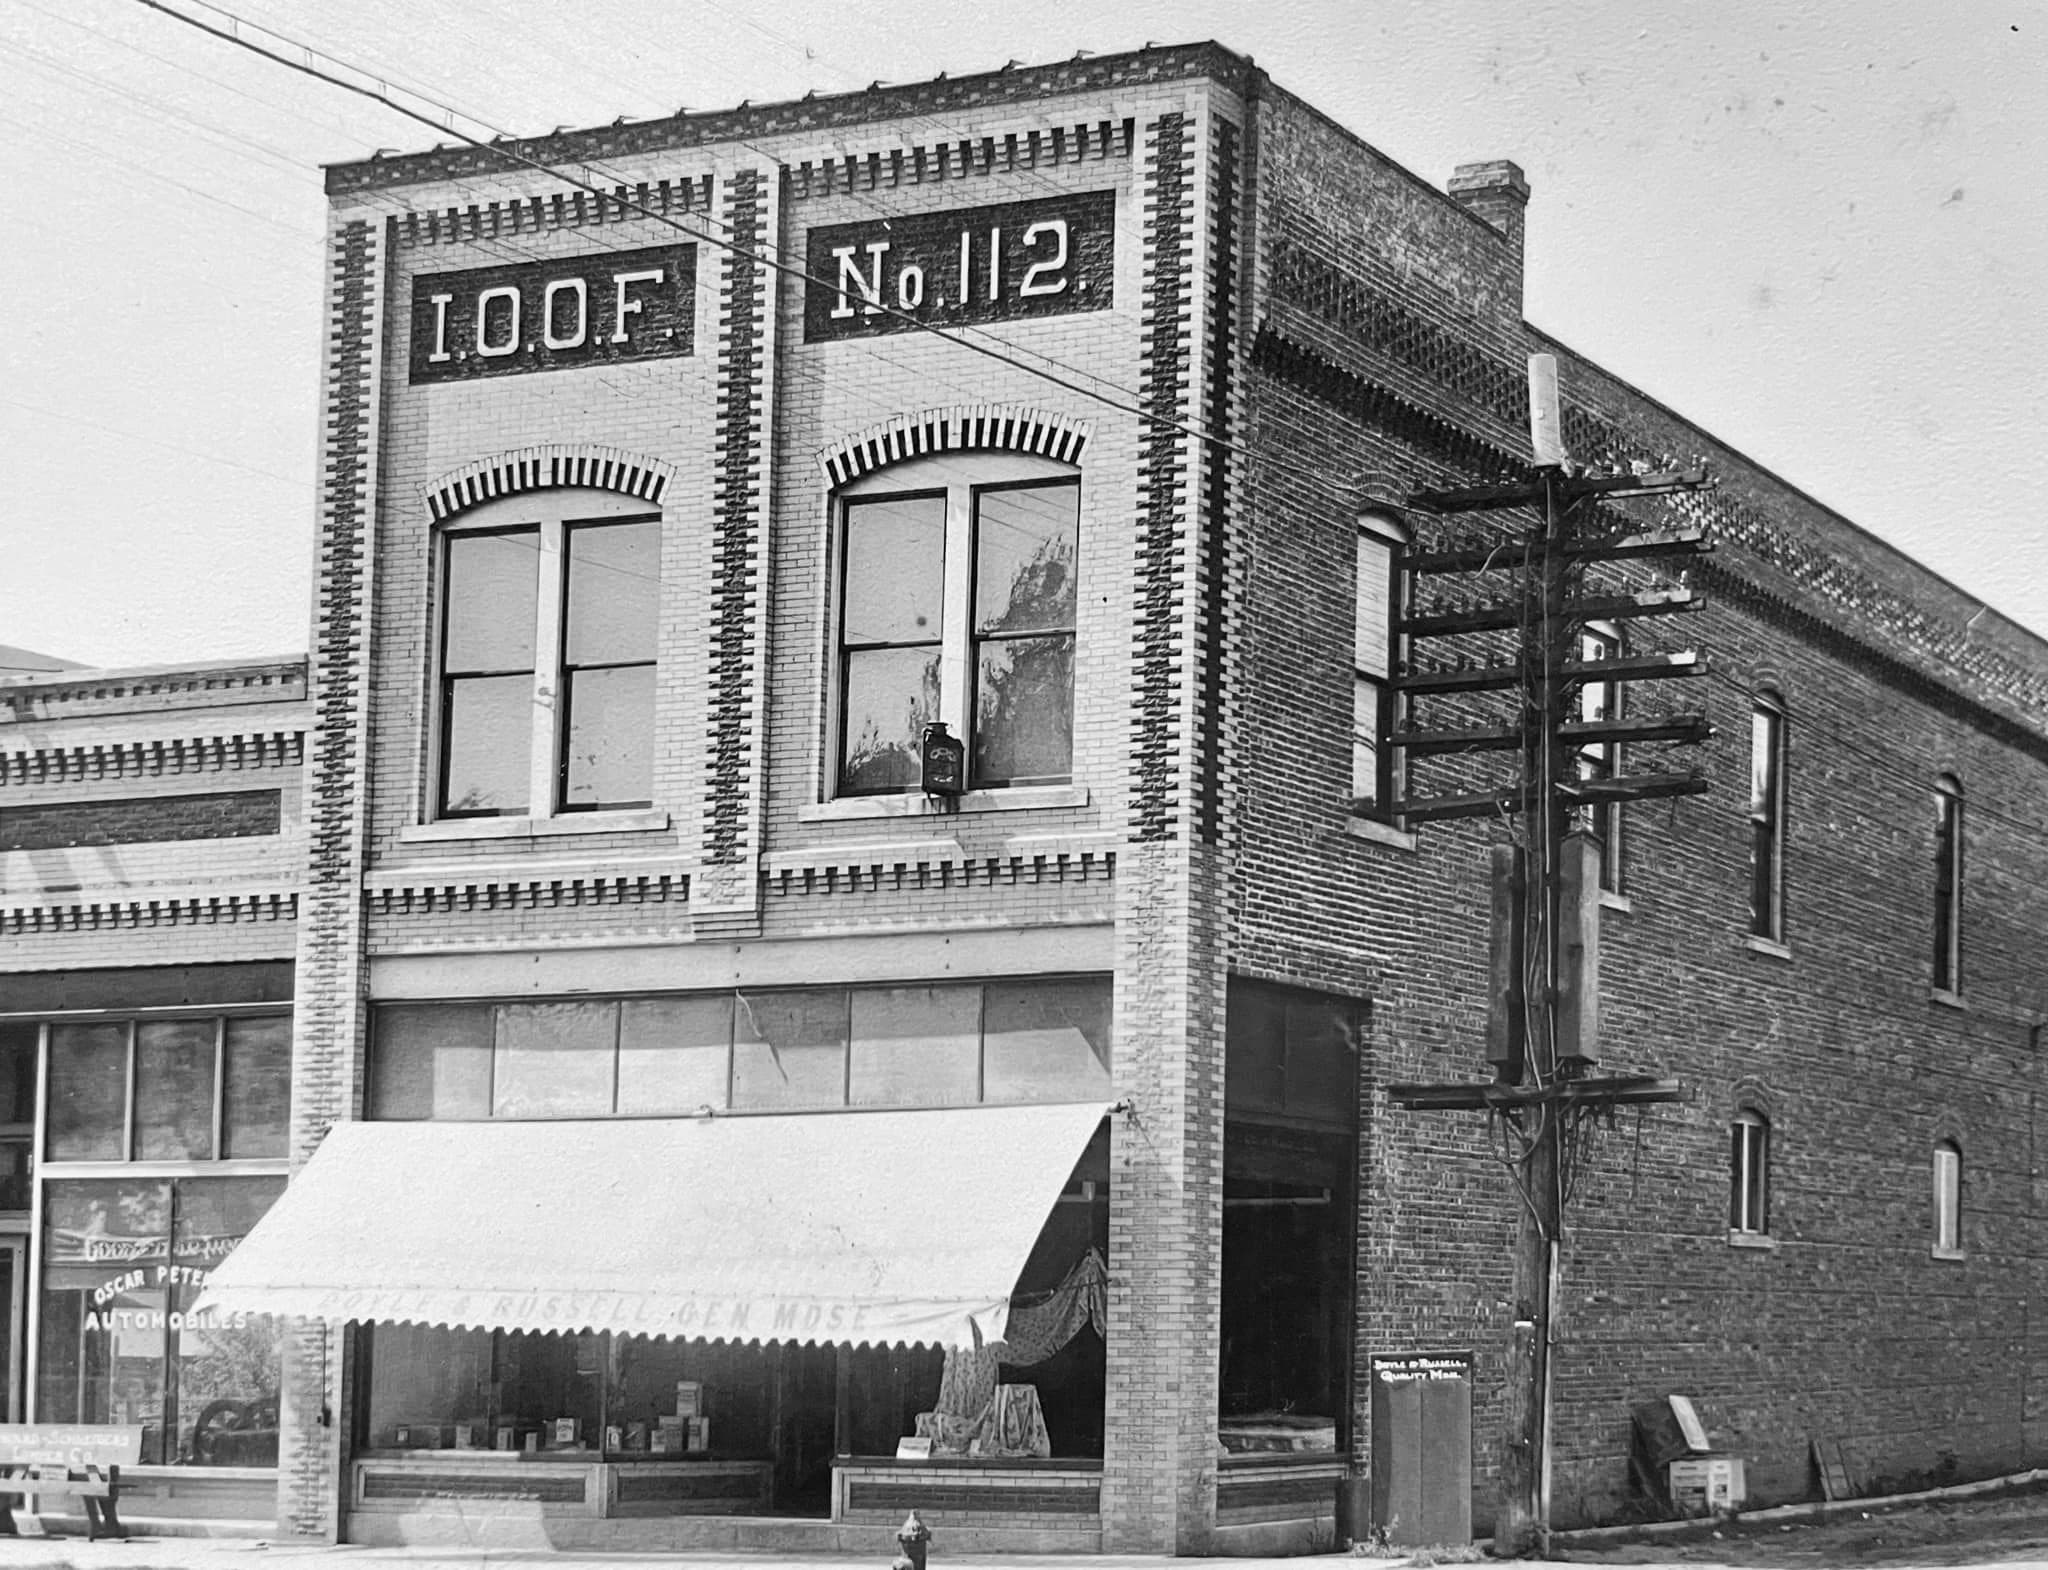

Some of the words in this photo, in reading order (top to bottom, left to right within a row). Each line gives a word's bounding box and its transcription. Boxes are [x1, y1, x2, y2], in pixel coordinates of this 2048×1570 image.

[94, 1269, 145, 1305] OSCAR
[157, 1265, 207, 1288] PETE
[85, 1310, 248, 1331] AUTOMOBILES
[771, 1301, 873, 1332] MDSE
